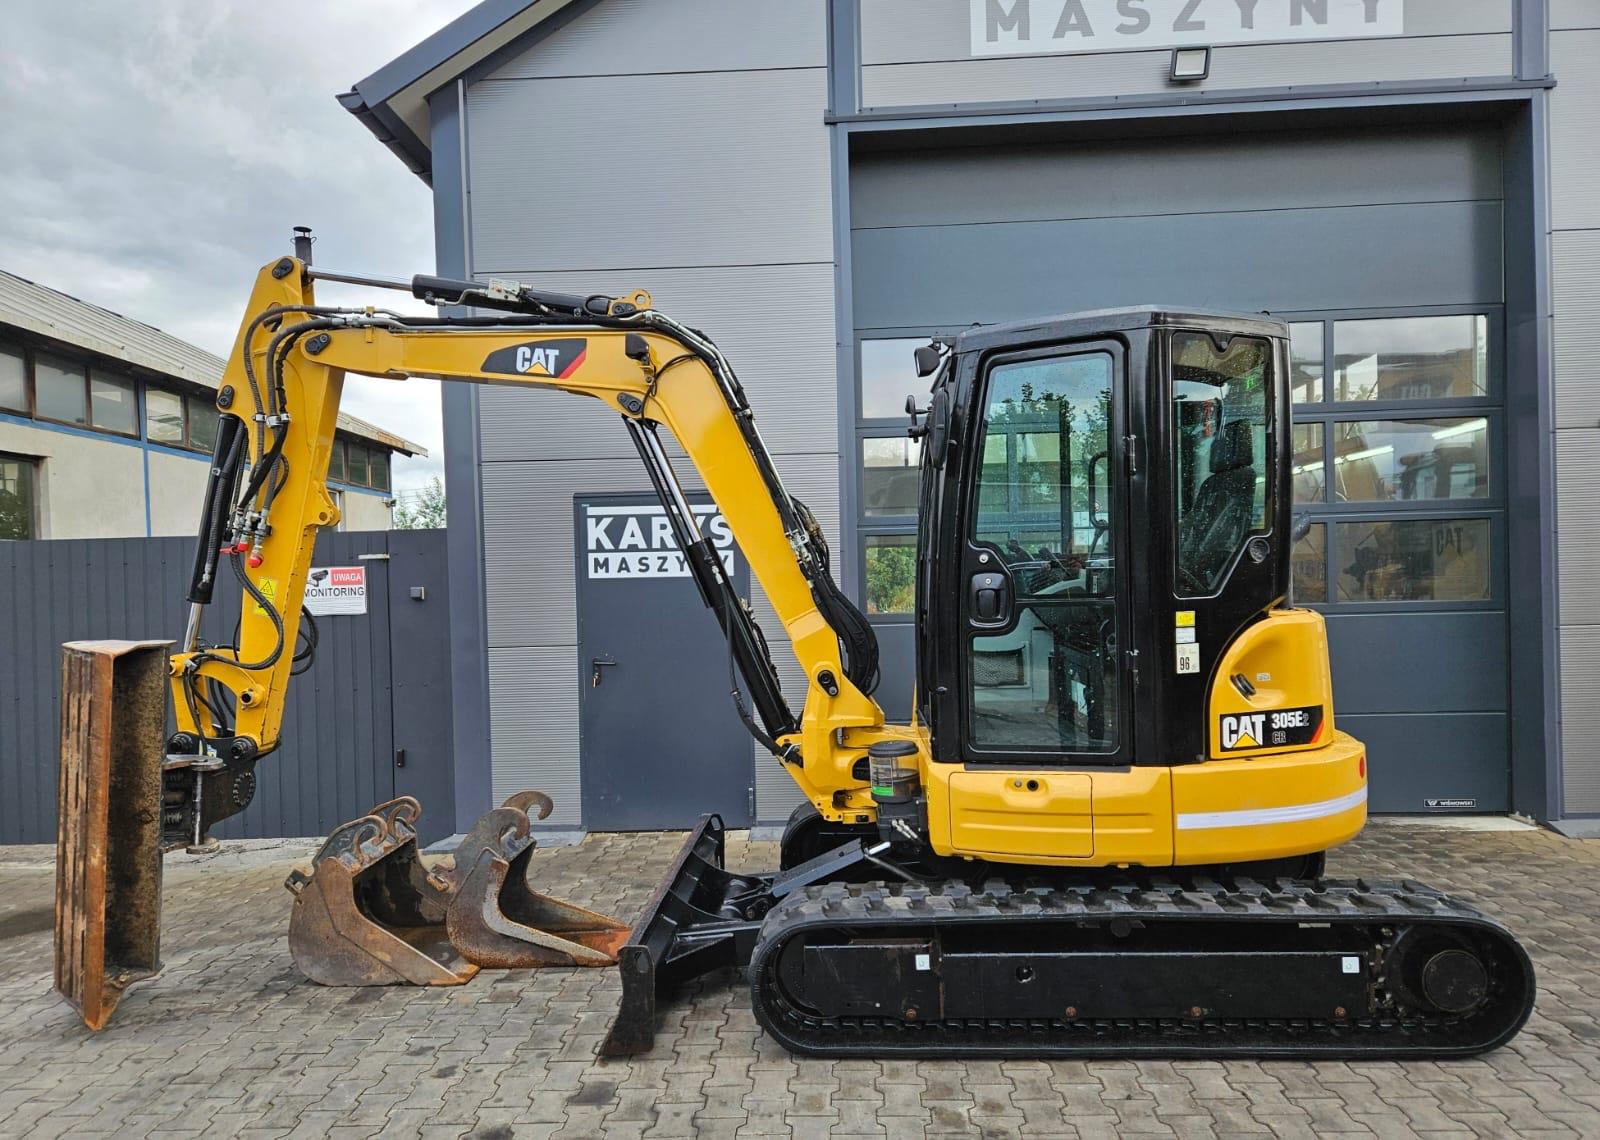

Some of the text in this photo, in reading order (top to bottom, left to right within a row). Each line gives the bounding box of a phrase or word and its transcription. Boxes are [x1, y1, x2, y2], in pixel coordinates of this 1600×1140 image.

[516, 346, 560, 375] CAT
[593, 555, 729, 574] MASZYY
[333, 572, 361, 582] UWAGA
[1179, 656, 1190, 671] 96
[1222, 714, 1266, 748] CAT
[1272, 730, 1287, 744] CR
